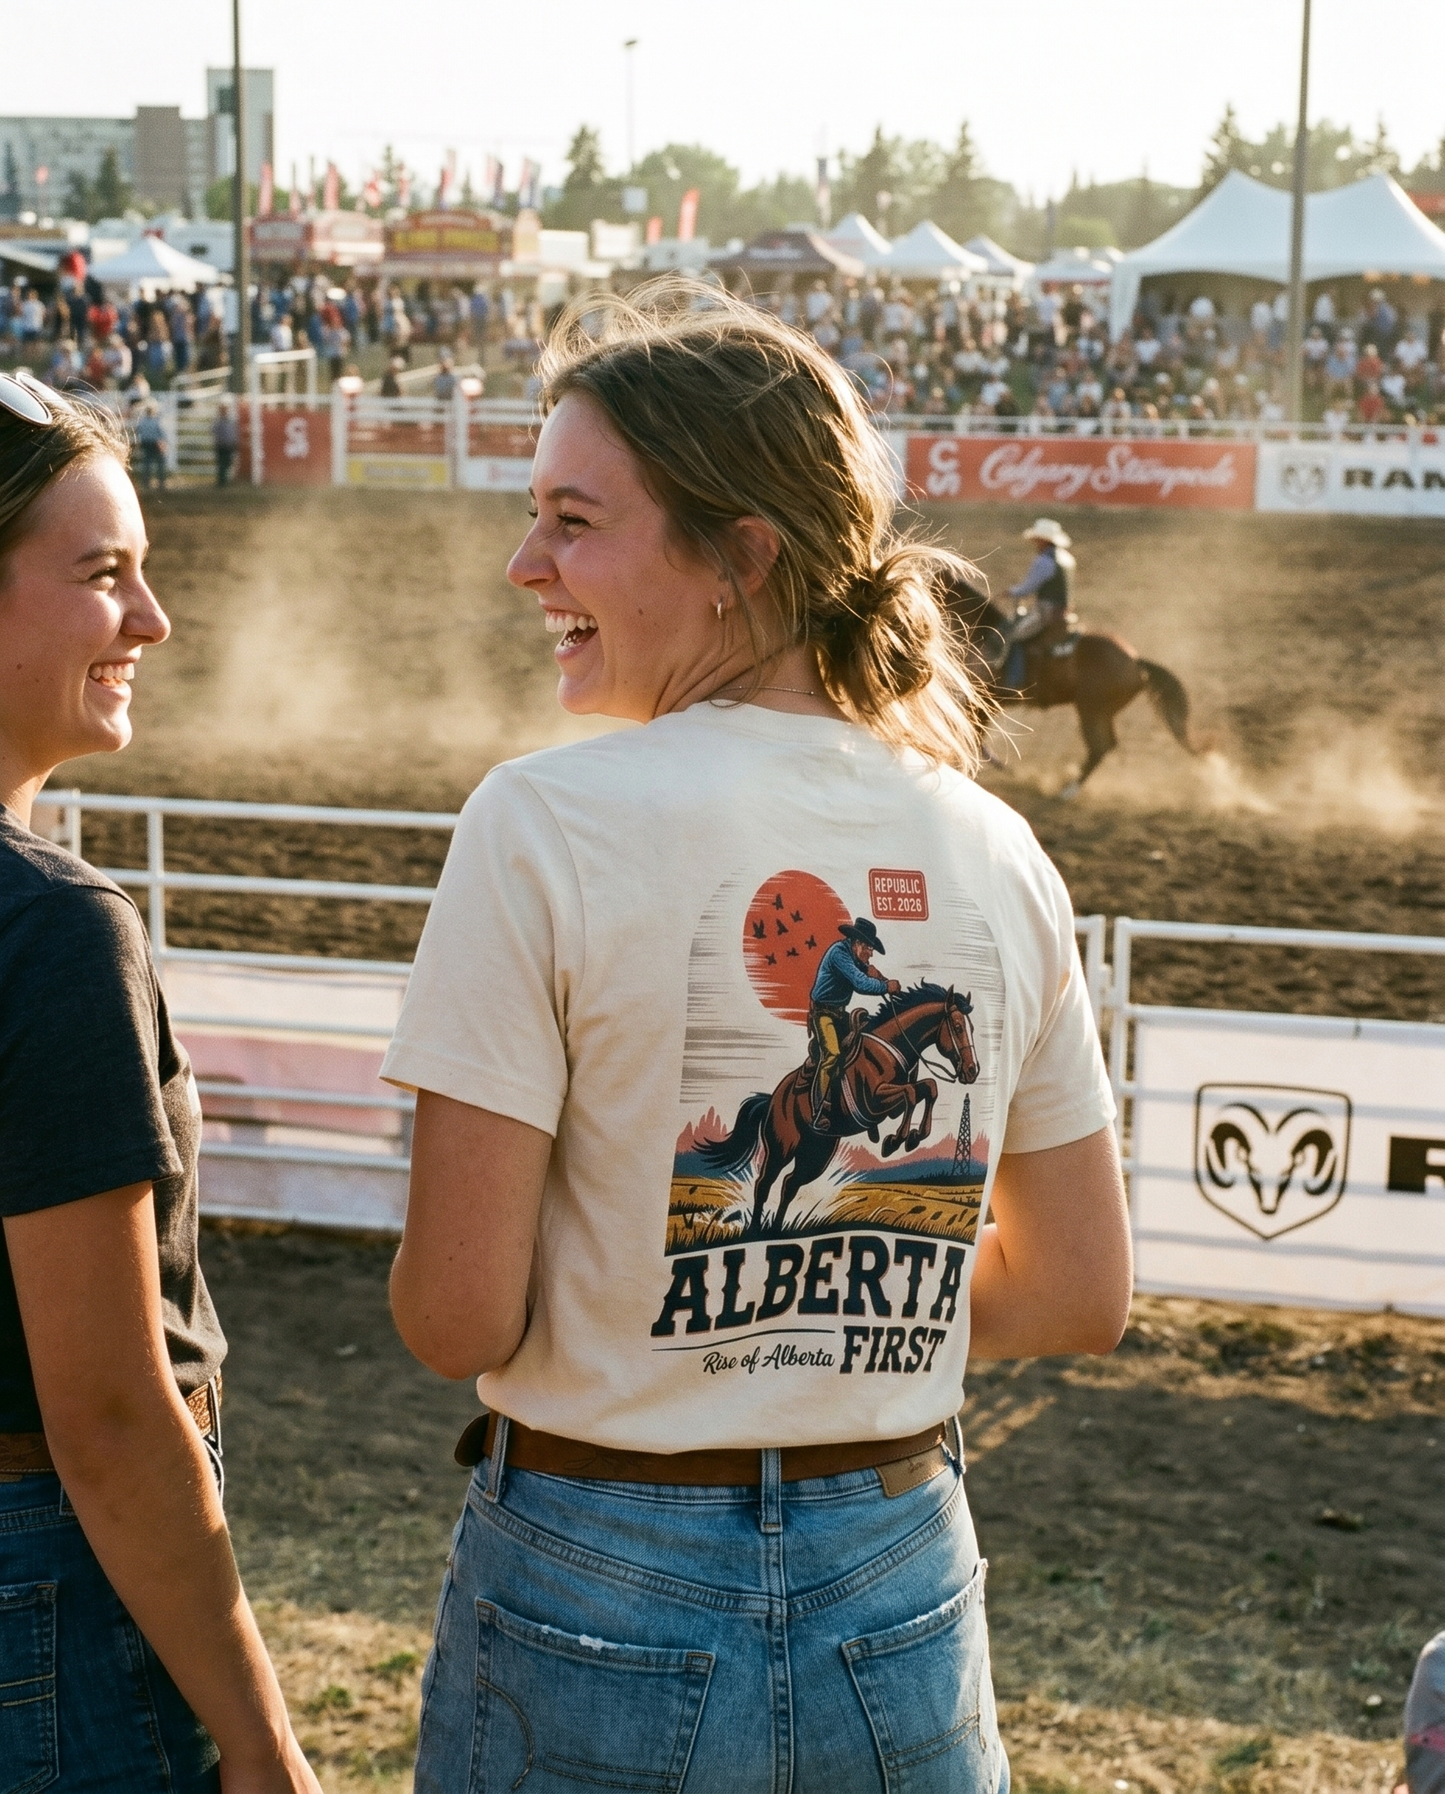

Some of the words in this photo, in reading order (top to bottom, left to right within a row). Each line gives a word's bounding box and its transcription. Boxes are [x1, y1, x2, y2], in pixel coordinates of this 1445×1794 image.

[874, 877, 921, 894] REPUBLIC
[876, 896, 896, 911] EST.
[650, 1235, 967, 1338] ALBERTA
[702, 1351, 738, 1375] Rise
[740, 1346, 761, 1375] of
[761, 1343, 835, 1370] Alberta
[839, 1325, 947, 1375] FIRST
